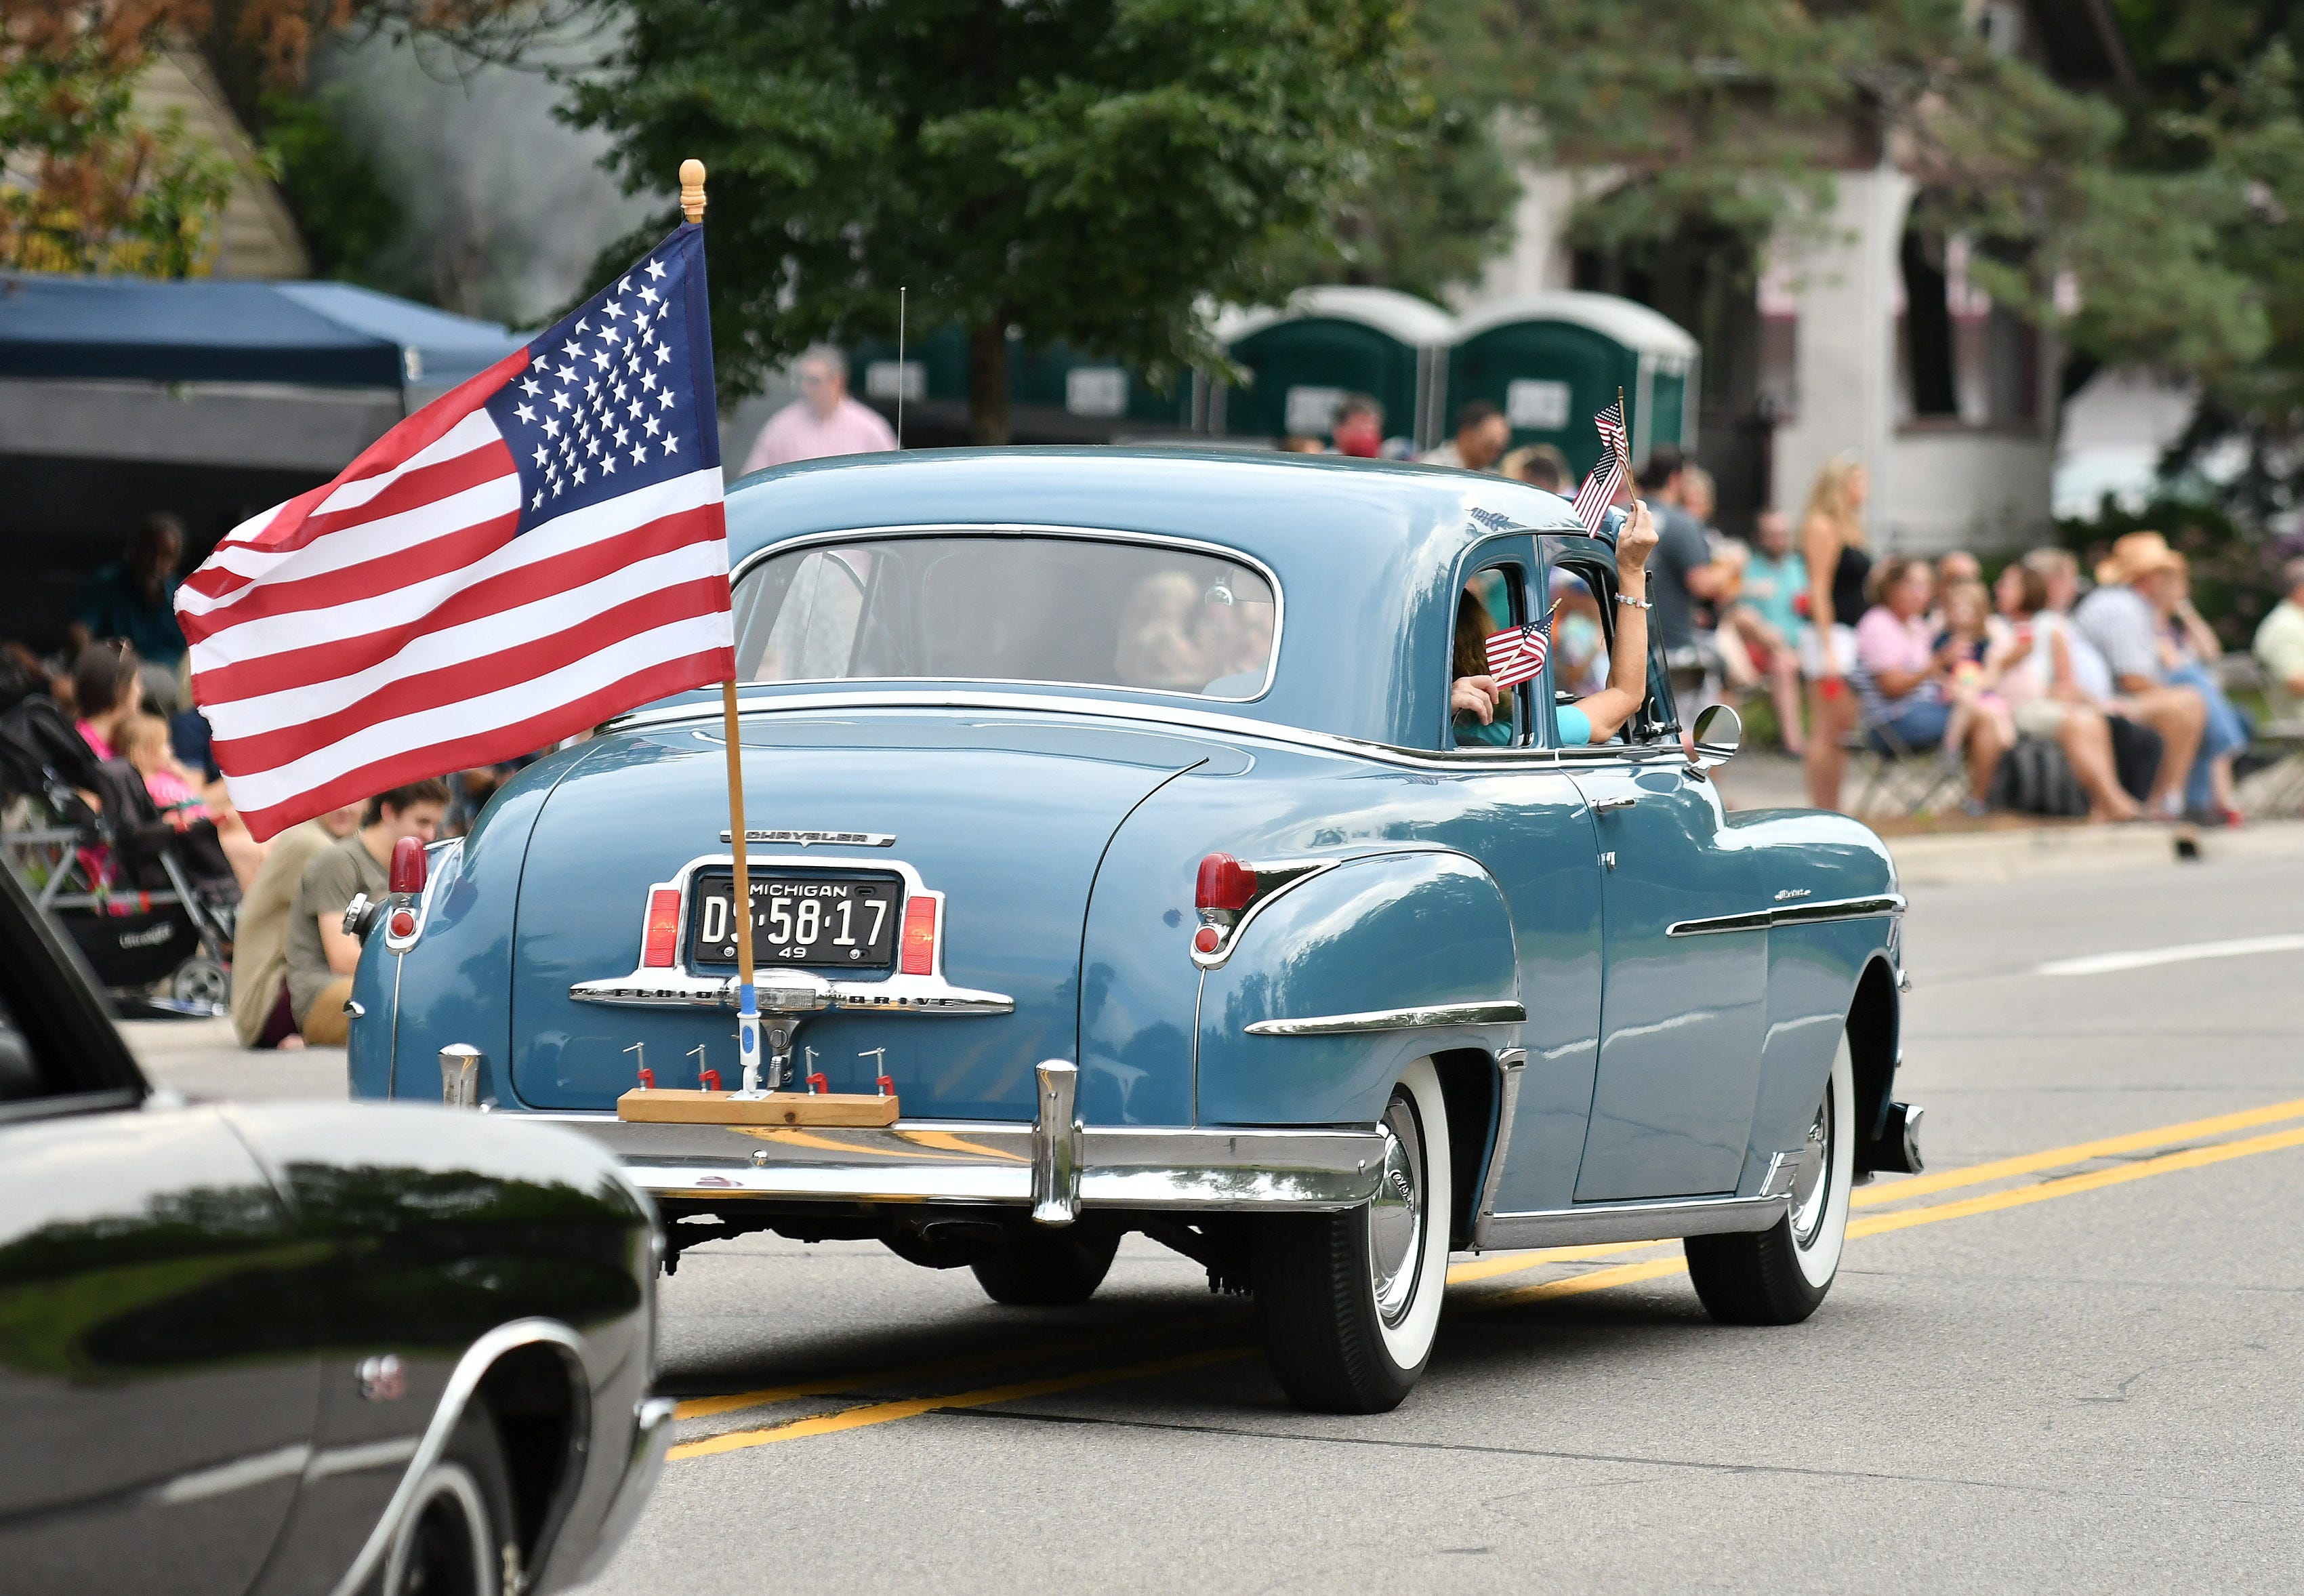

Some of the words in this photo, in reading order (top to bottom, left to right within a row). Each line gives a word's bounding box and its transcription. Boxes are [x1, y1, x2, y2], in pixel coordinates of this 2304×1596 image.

[745, 831, 867, 842] CHRYSLER
[749, 884, 847, 897] MICHIGAN
[778, 947, 806, 958] 49
[614, 989, 712, 998] FLUID
[849, 996, 954, 1007] DRIVE
